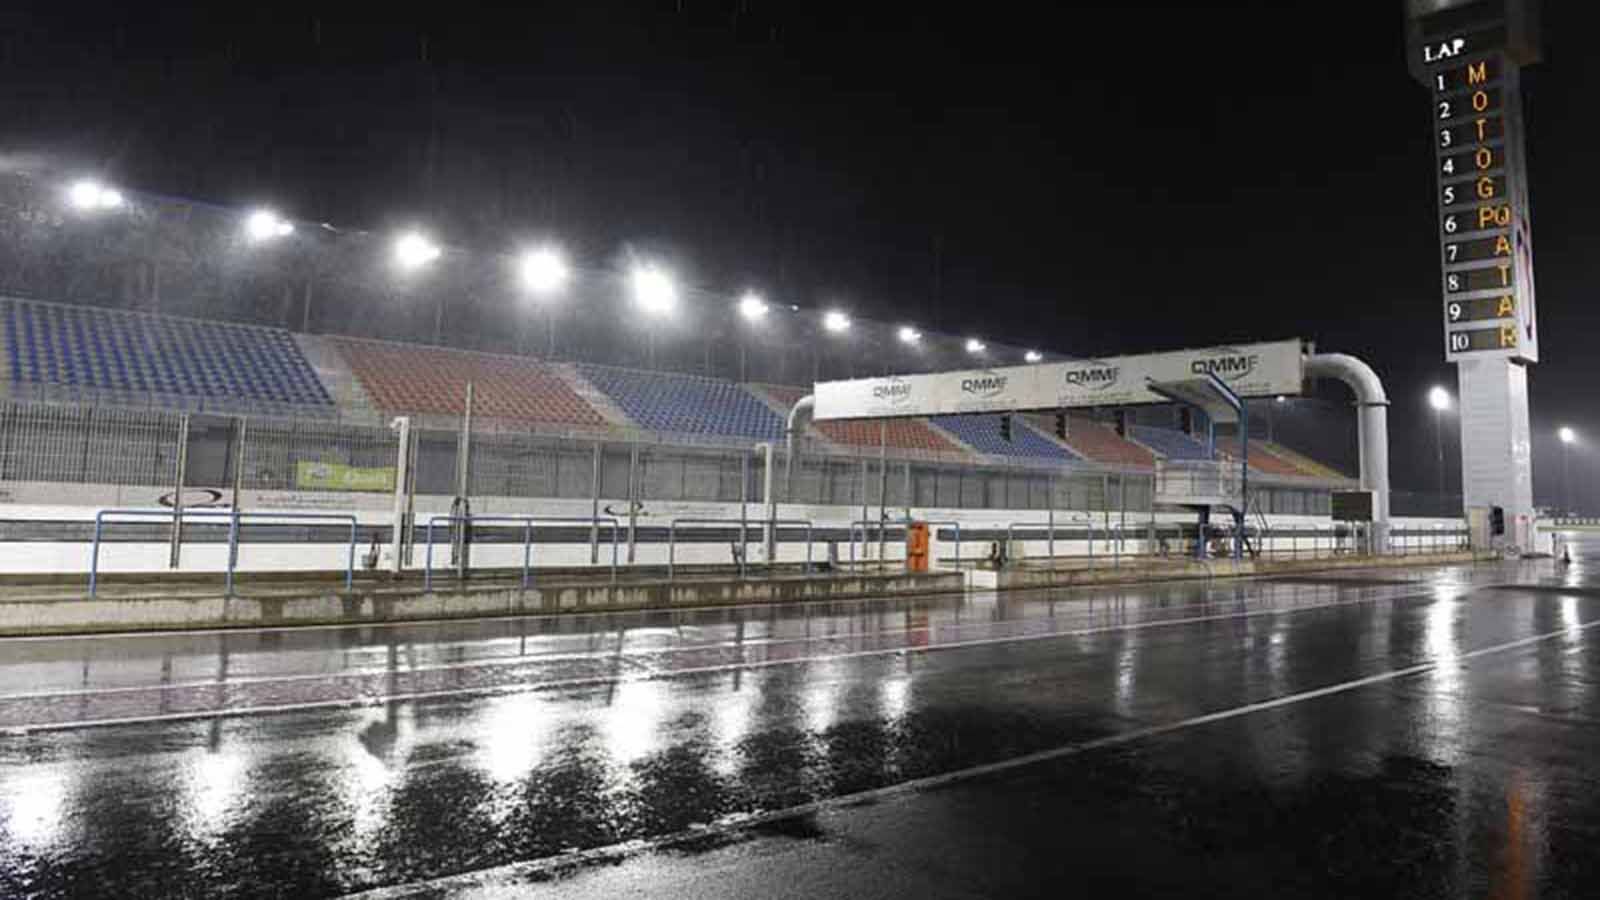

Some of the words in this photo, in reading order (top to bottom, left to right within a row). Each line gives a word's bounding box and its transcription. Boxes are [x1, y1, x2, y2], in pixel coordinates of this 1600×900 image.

[1424, 38, 1465, 62] LAP
[1438, 75, 1444, 90] 1
[1440, 102, 1451, 118] 2
[1441, 130, 1451, 147] 3
[1443, 158, 1454, 173] 4
[1445, 187, 1455, 204] 5
[1445, 216, 1457, 233] 6
[1447, 245, 1457, 261] 7
[1448, 274, 1459, 291] 8
[1450, 303, 1461, 320] 9
[1452, 333, 1469, 350] 10
[1191, 355, 1259, 375] QMMF
[1066, 367, 1120, 386] QMMF
